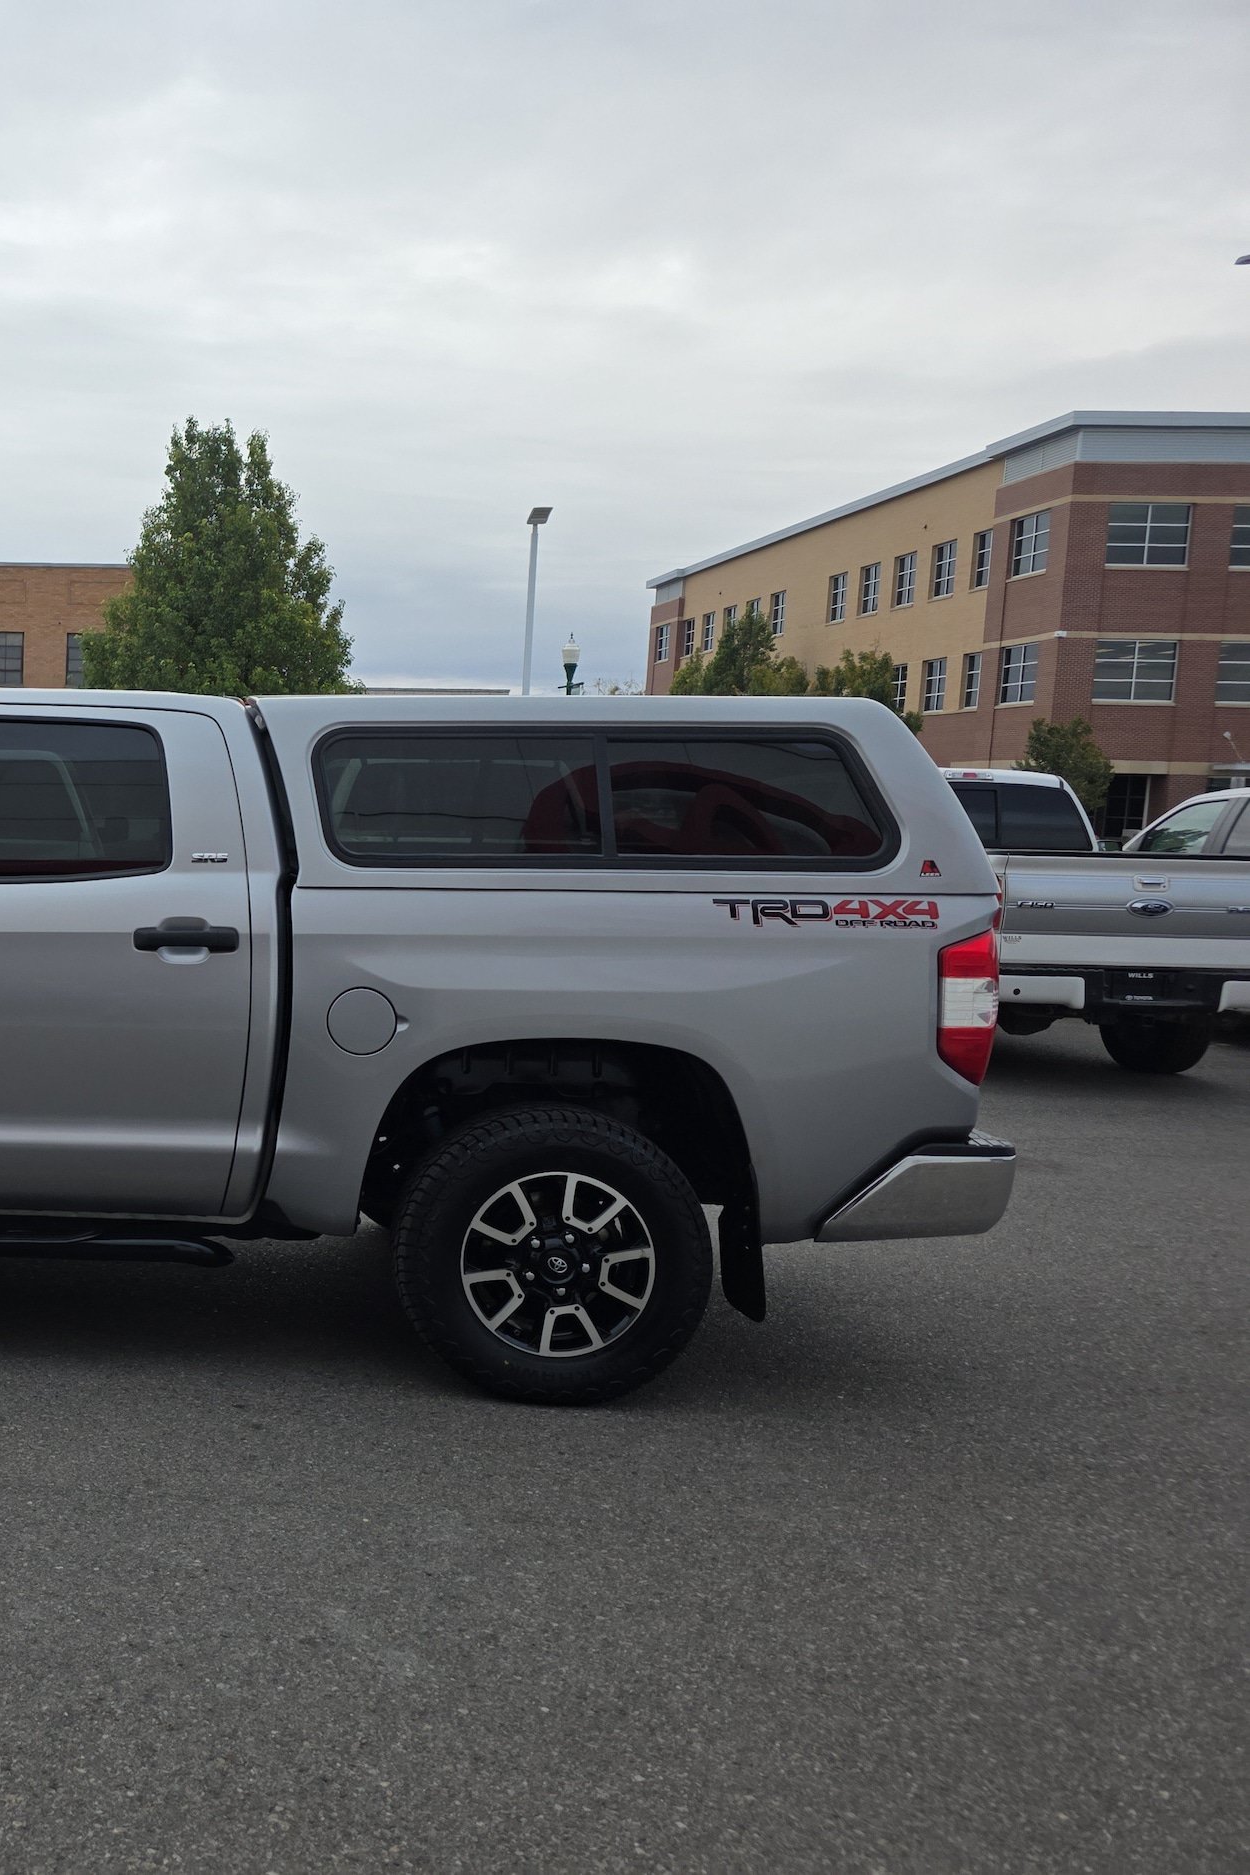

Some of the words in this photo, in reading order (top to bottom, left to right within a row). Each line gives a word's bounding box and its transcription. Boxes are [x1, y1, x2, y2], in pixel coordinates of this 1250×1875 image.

[191, 852, 229, 863] SR5
[712, 898, 833, 928] TRD
[835, 919, 877, 929] OFF
[879, 919, 938, 930] ROAD
